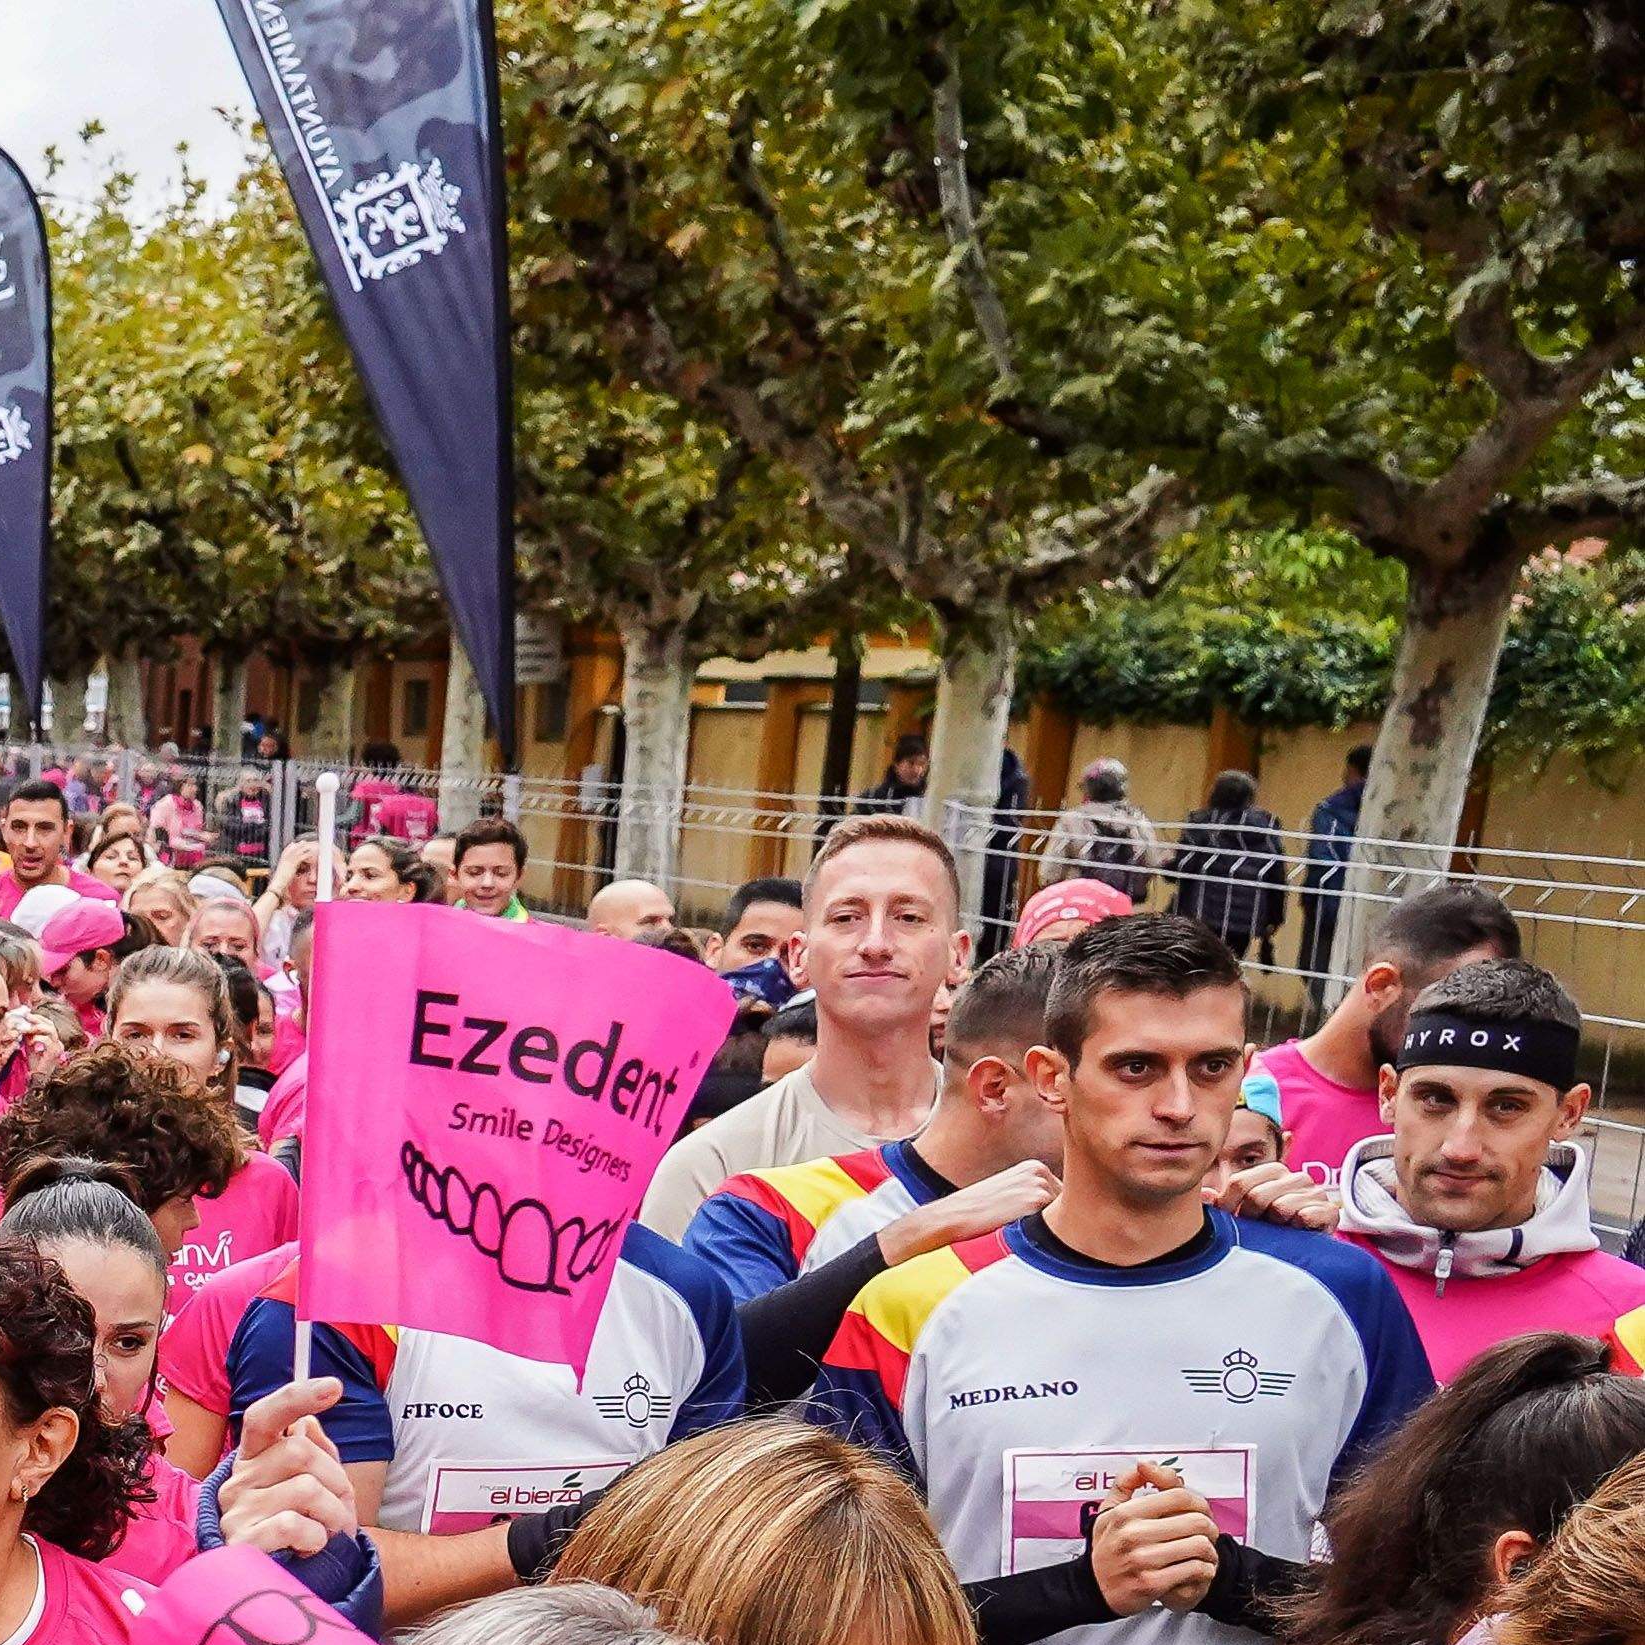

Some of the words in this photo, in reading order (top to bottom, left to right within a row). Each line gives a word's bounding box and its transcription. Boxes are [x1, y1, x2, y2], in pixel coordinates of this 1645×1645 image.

[1404, 1028, 1521, 1052] HYROX
[409, 988, 679, 1138] Ezedent
[448, 1102, 534, 1142] Smile
[541, 1117, 632, 1183] Designers
[950, 1380, 1079, 1410] MEDRANO
[401, 1403, 484, 1420] FIFOCE
